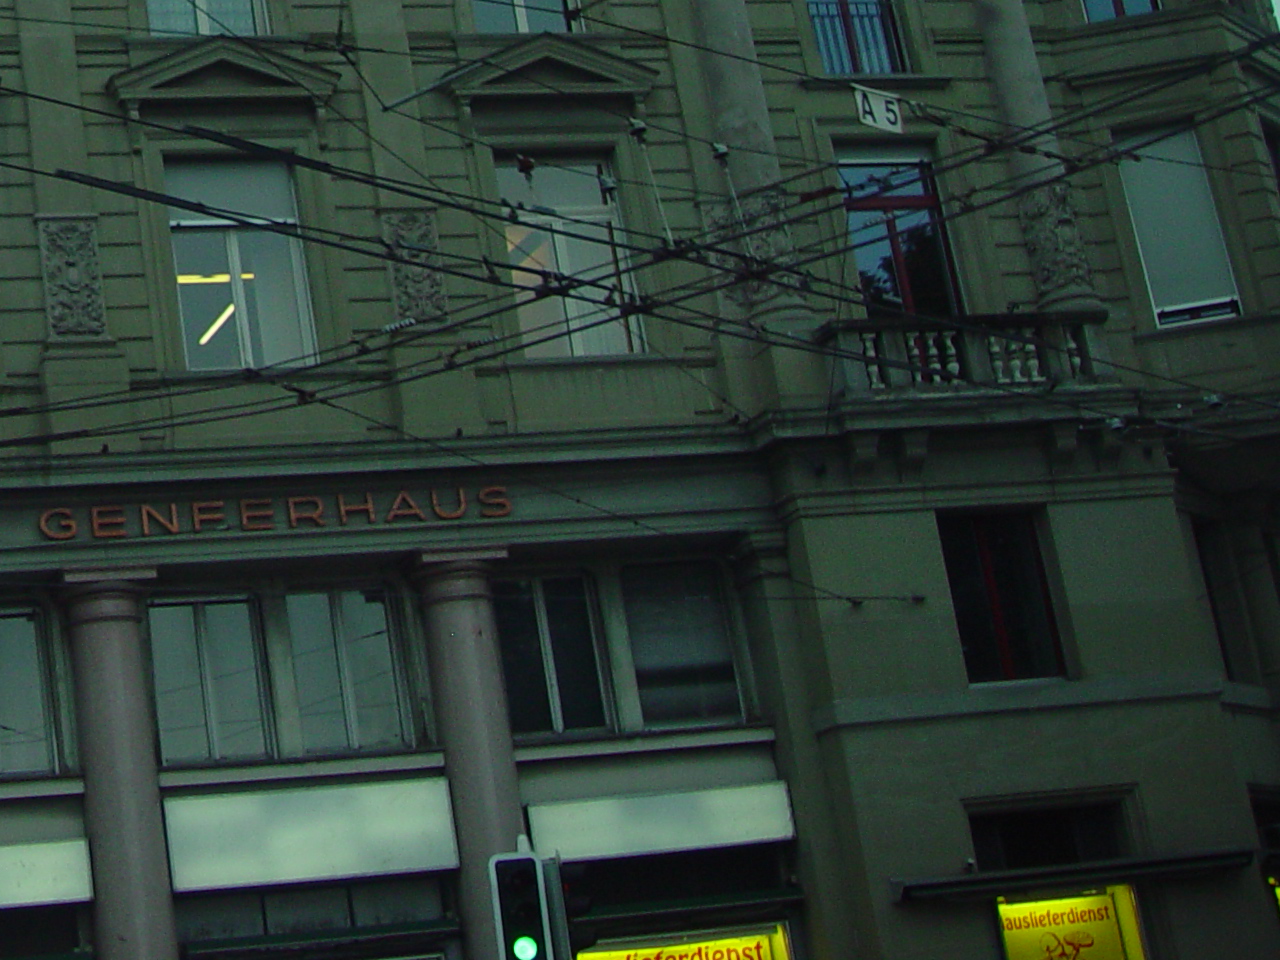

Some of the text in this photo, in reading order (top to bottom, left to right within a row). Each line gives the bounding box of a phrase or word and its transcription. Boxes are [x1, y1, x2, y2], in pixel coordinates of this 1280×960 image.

[861, 92, 898, 126] A 5
[39, 486, 514, 539] GENFERHAUS
[1001, 905, 1110, 931] auslieferdienst
